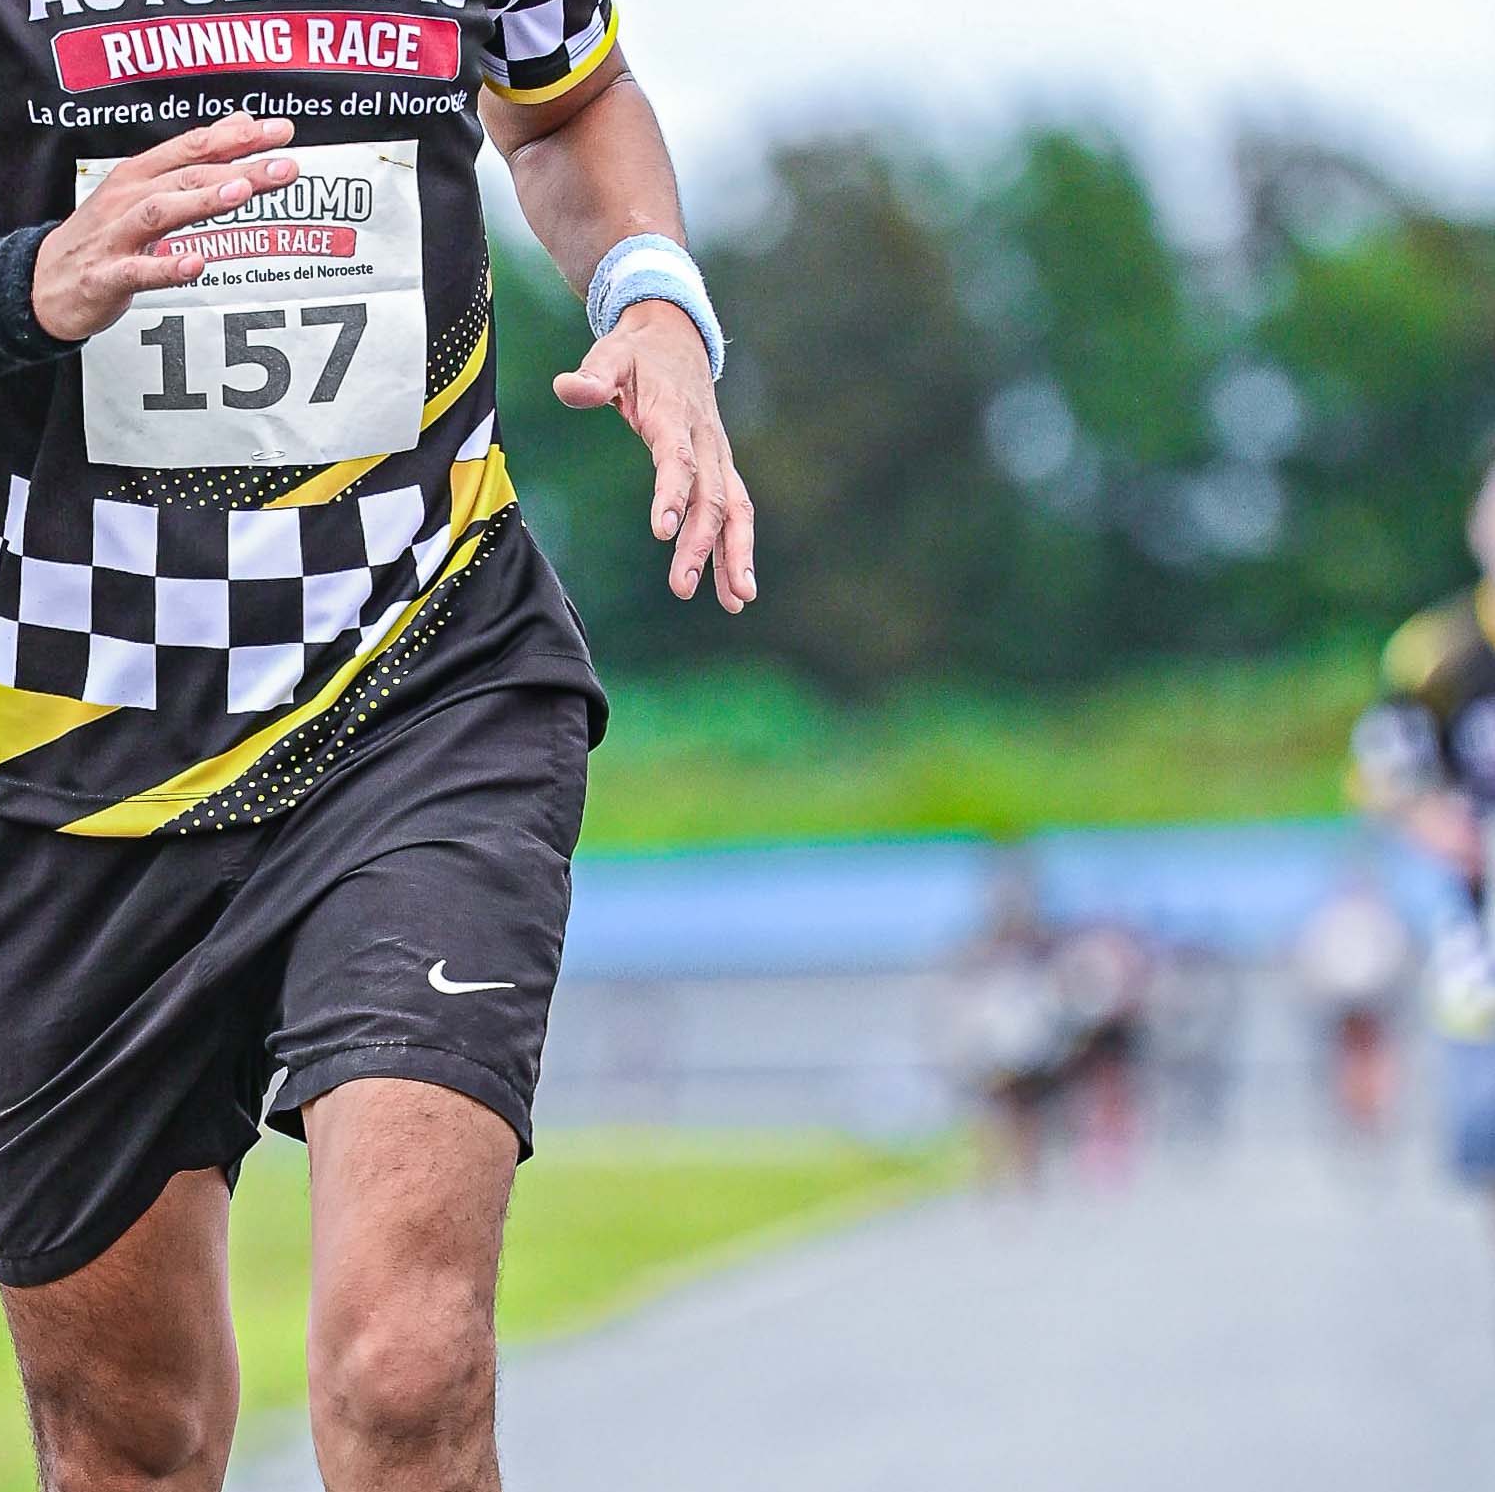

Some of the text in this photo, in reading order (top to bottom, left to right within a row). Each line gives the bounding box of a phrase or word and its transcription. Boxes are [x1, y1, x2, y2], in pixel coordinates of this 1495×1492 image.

[102, 18, 421, 80] RUNNING RACE
[27, 99, 54, 126] La
[58, 101, 154, 127] Carrera
[159, 94, 191, 120] de
[198, 93, 235, 117] los
[241, 91, 333, 116] Clubes
[340, 91, 382, 116] del
[170, 229, 334, 259] RUNNING RACE
[201, 272, 220, 287] de
[222, 271, 242, 285] los
[245, 267, 290, 284] Clubes
[293, 265, 314, 281] del
[317, 263, 374, 278] Noroeste
[140, 303, 368, 411] 157
